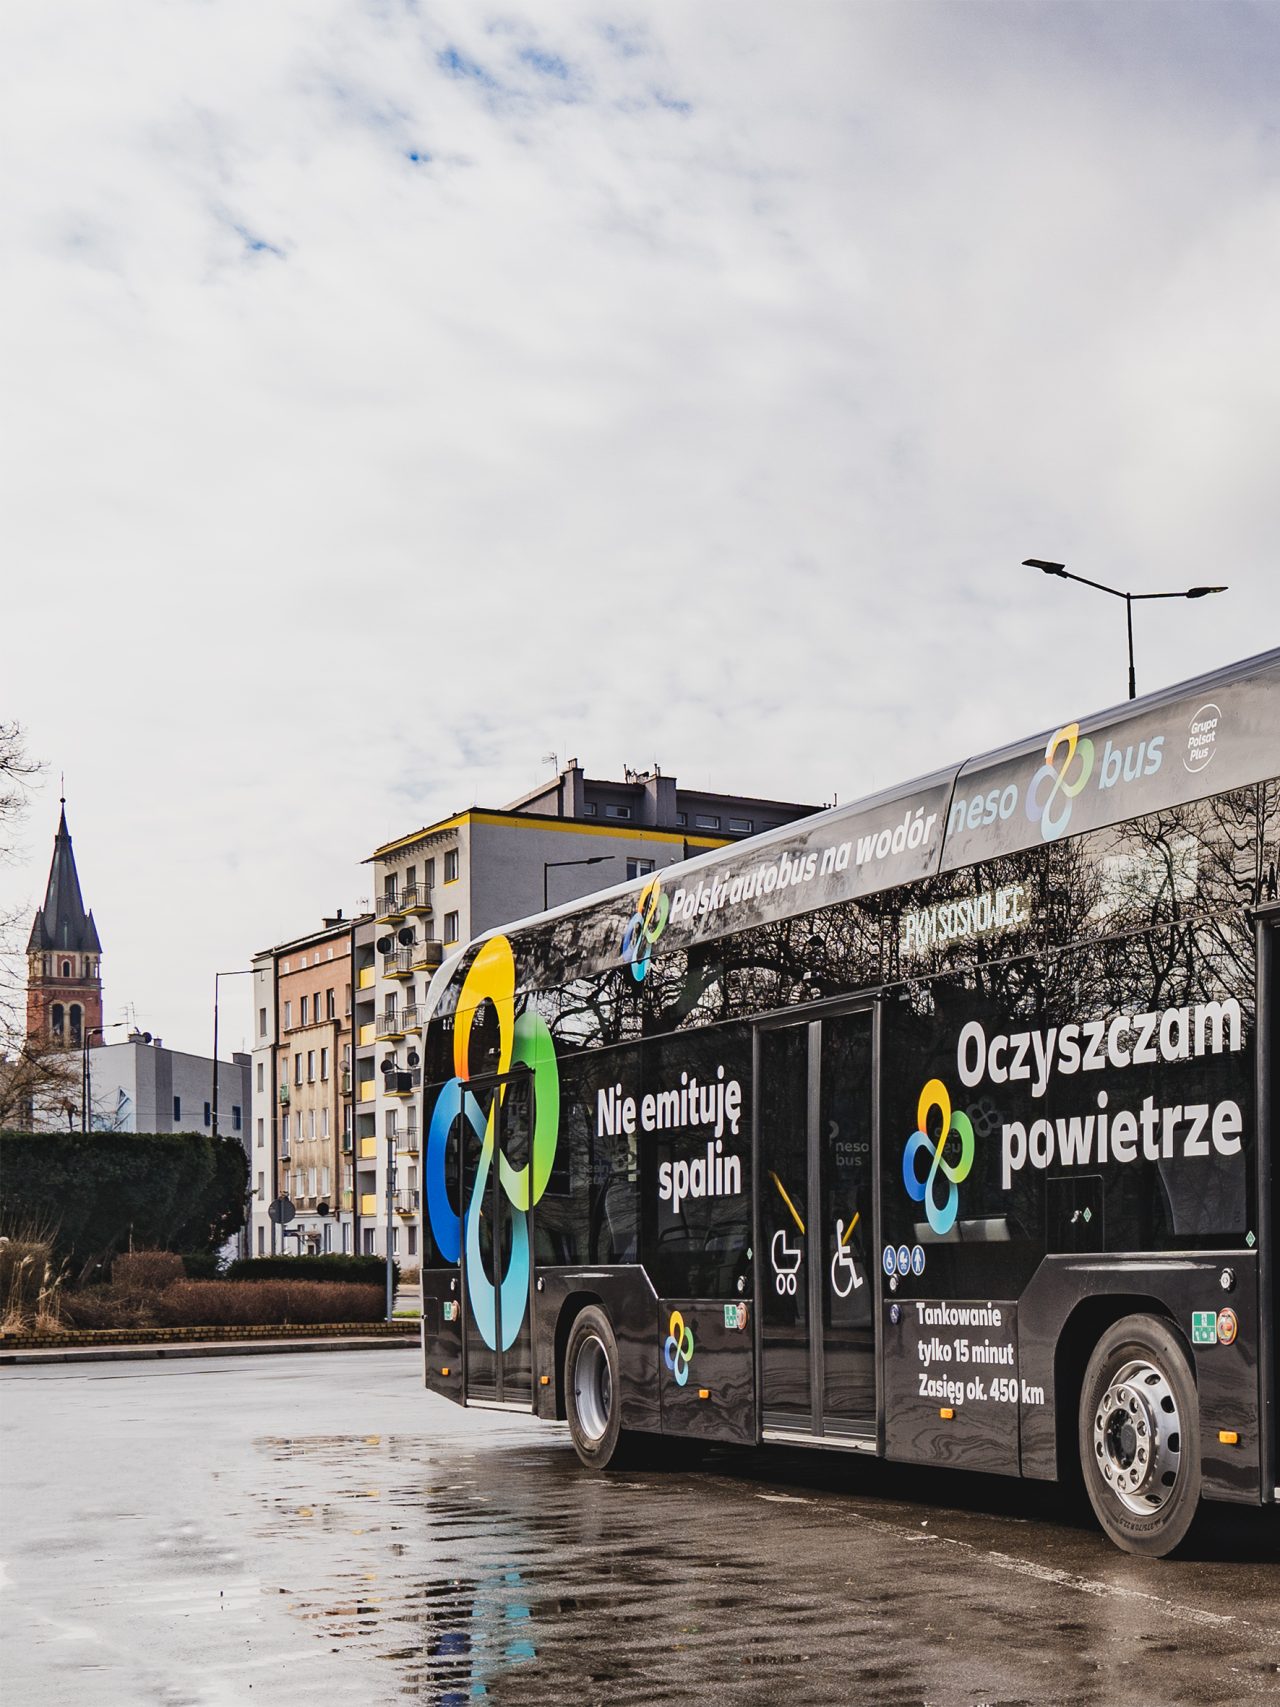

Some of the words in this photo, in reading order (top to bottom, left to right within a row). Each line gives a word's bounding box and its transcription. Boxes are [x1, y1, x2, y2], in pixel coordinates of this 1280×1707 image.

[1188, 731, 1216, 749] Polsat
[1190, 748, 1209, 761] Plus
[1191, 718, 1218, 734] Grupa
[948, 784, 1018, 834] neso
[1099, 736, 1164, 789] bus
[669, 871, 730, 923] Polski
[730, 847, 818, 904] autobus
[820, 842, 852, 876] na
[856, 807, 937, 865] wodór
[906, 907, 937, 948] PKM
[938, 886, 1024, 941] SOSNOWIEC
[957, 998, 1241, 1097] Oczyszczam
[597, 1083, 636, 1137] Nie
[641, 1065, 742, 1138] emituję
[1001, 1091, 1243, 1190] powietrze
[659, 1140, 741, 1214] spalin
[916, 1302, 1002, 1327] Tankowanie
[918, 1338, 952, 1367] tylko
[953, 1340, 970, 1363] 15
[972, 1339, 1014, 1365] minut
[919, 1373, 964, 1405] Zasięg
[966, 1376, 988, 1401] ok.
[989, 1378, 1018, 1403] 450
[1021, 1380, 1045, 1405] km
